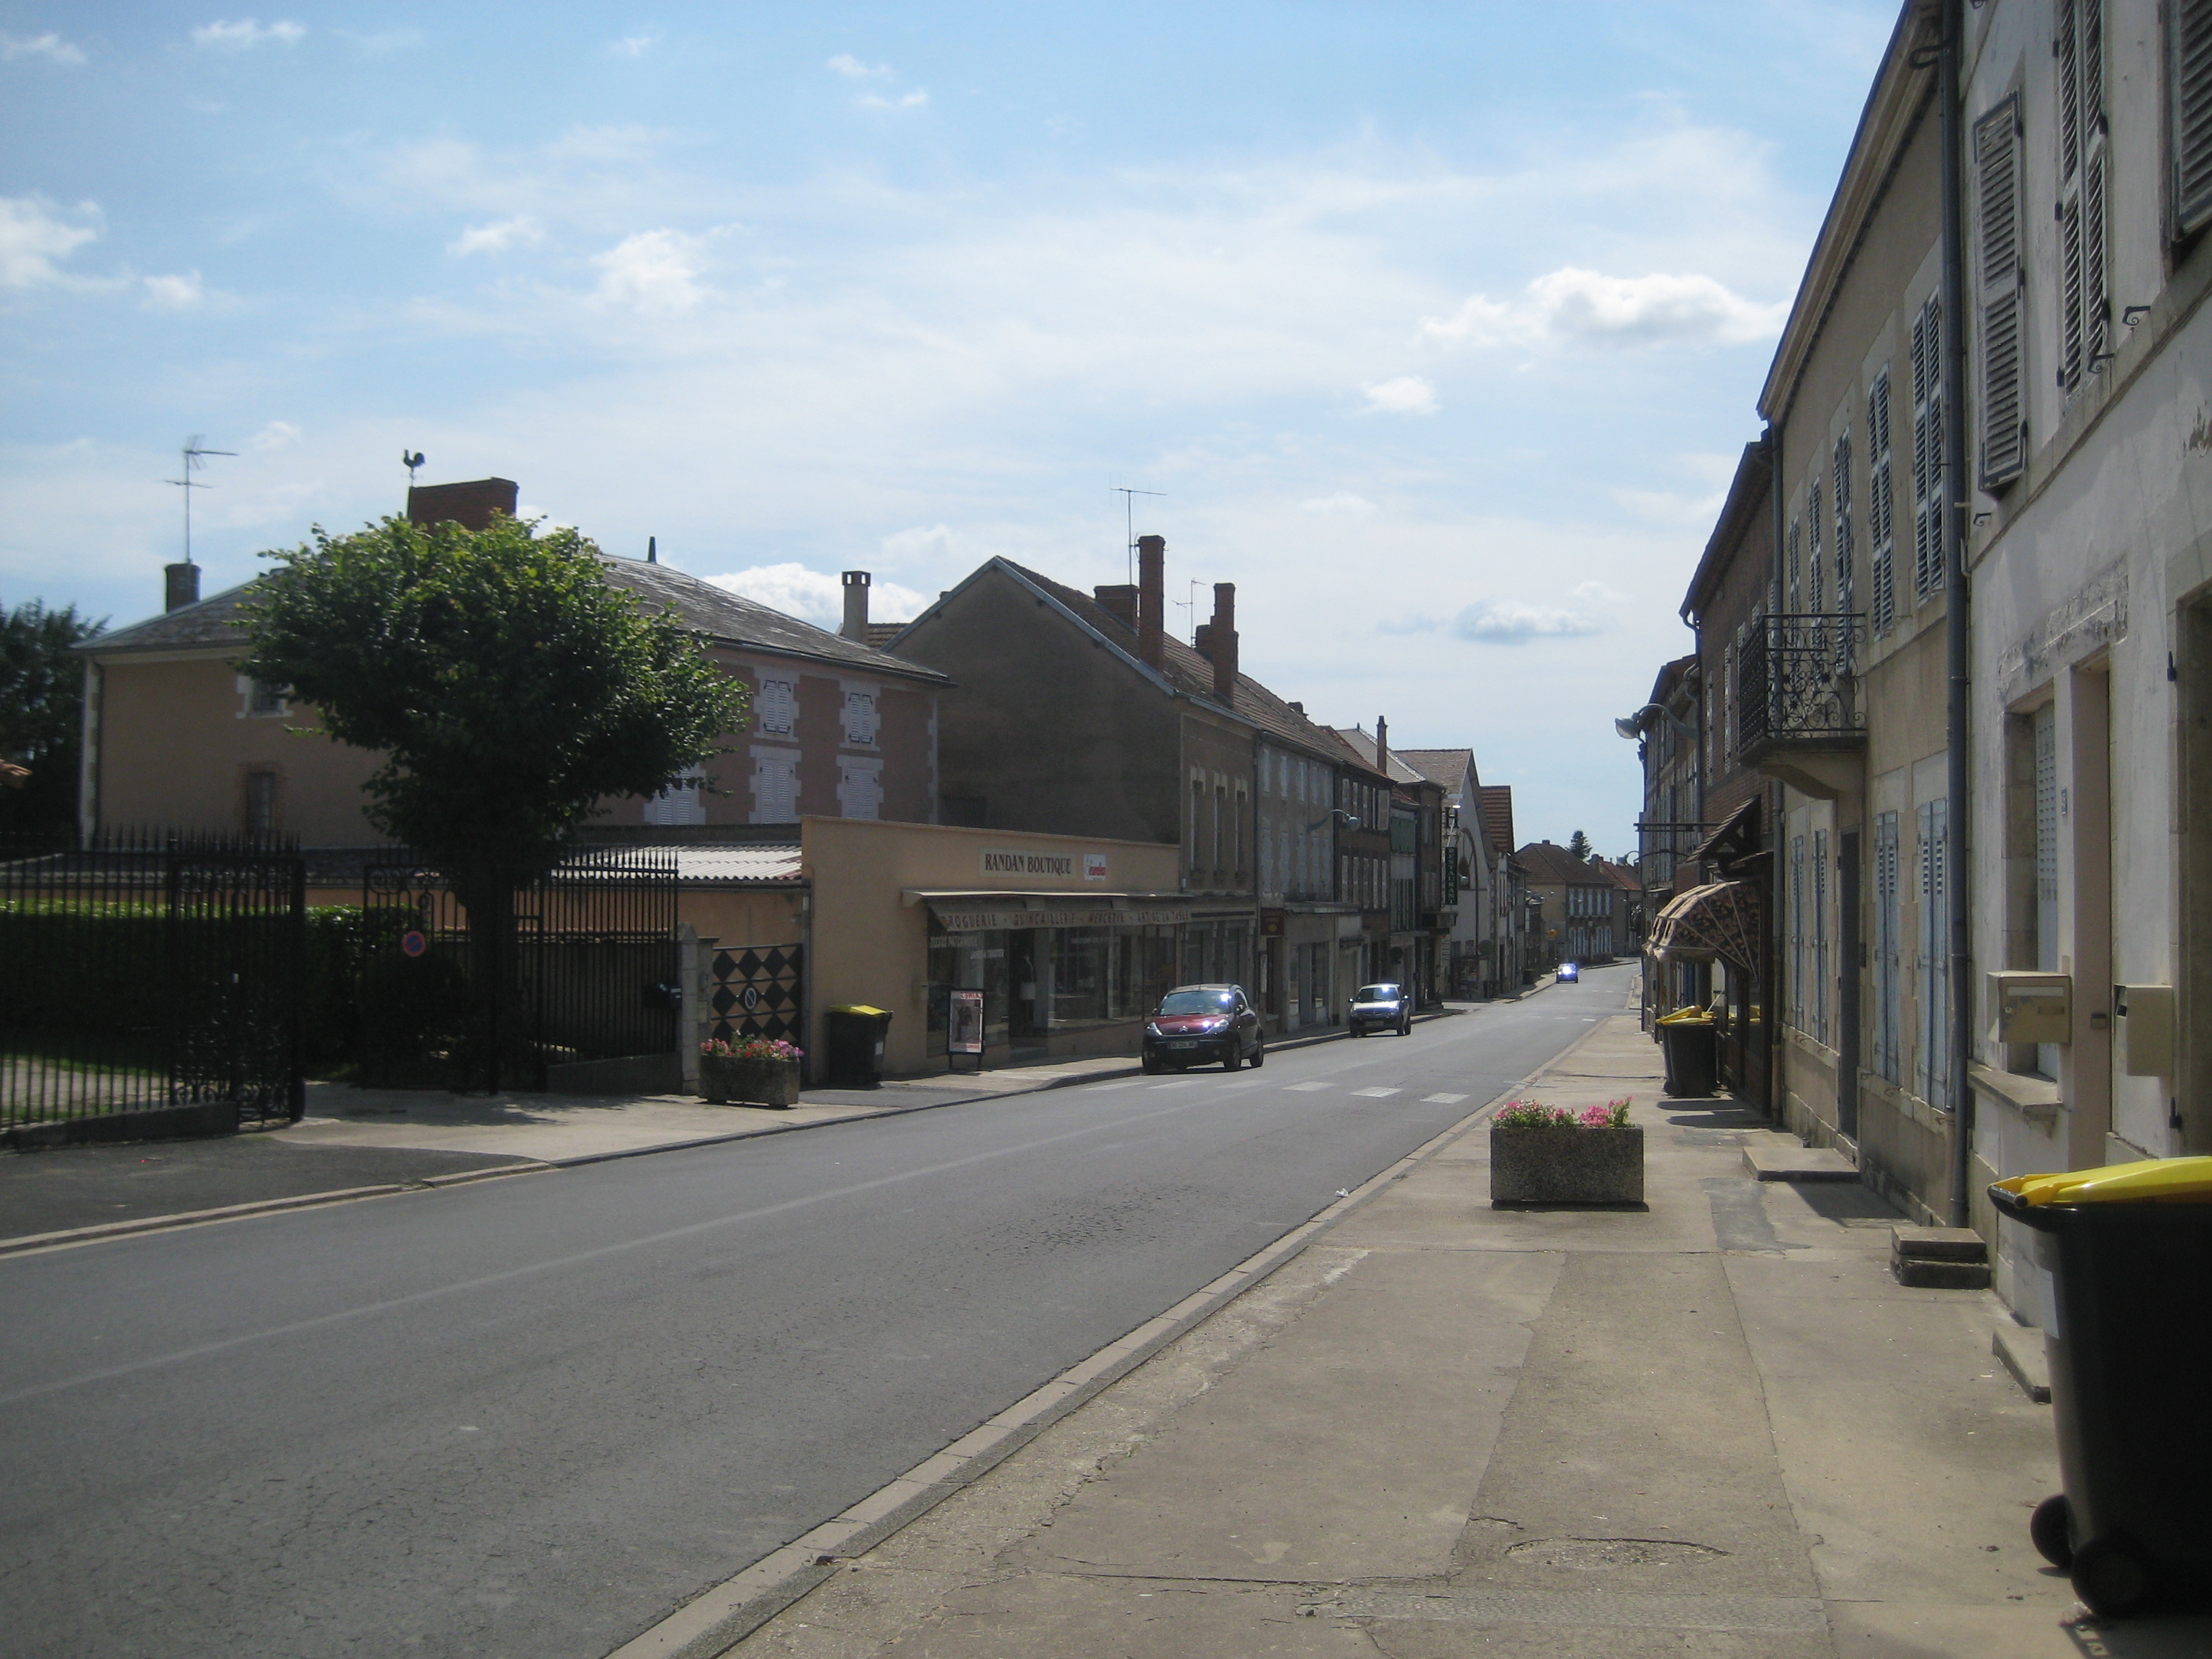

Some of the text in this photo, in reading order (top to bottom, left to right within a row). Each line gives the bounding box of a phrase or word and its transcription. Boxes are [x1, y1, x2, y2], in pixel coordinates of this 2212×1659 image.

[985, 853, 1071, 876] RANDAN BOUTIQUE
[1447, 848, 1456, 904] RESTAURANT
[1014, 912, 1075, 926] QUINCAILLERIE
[1088, 911, 1125, 924] MERCERIE
